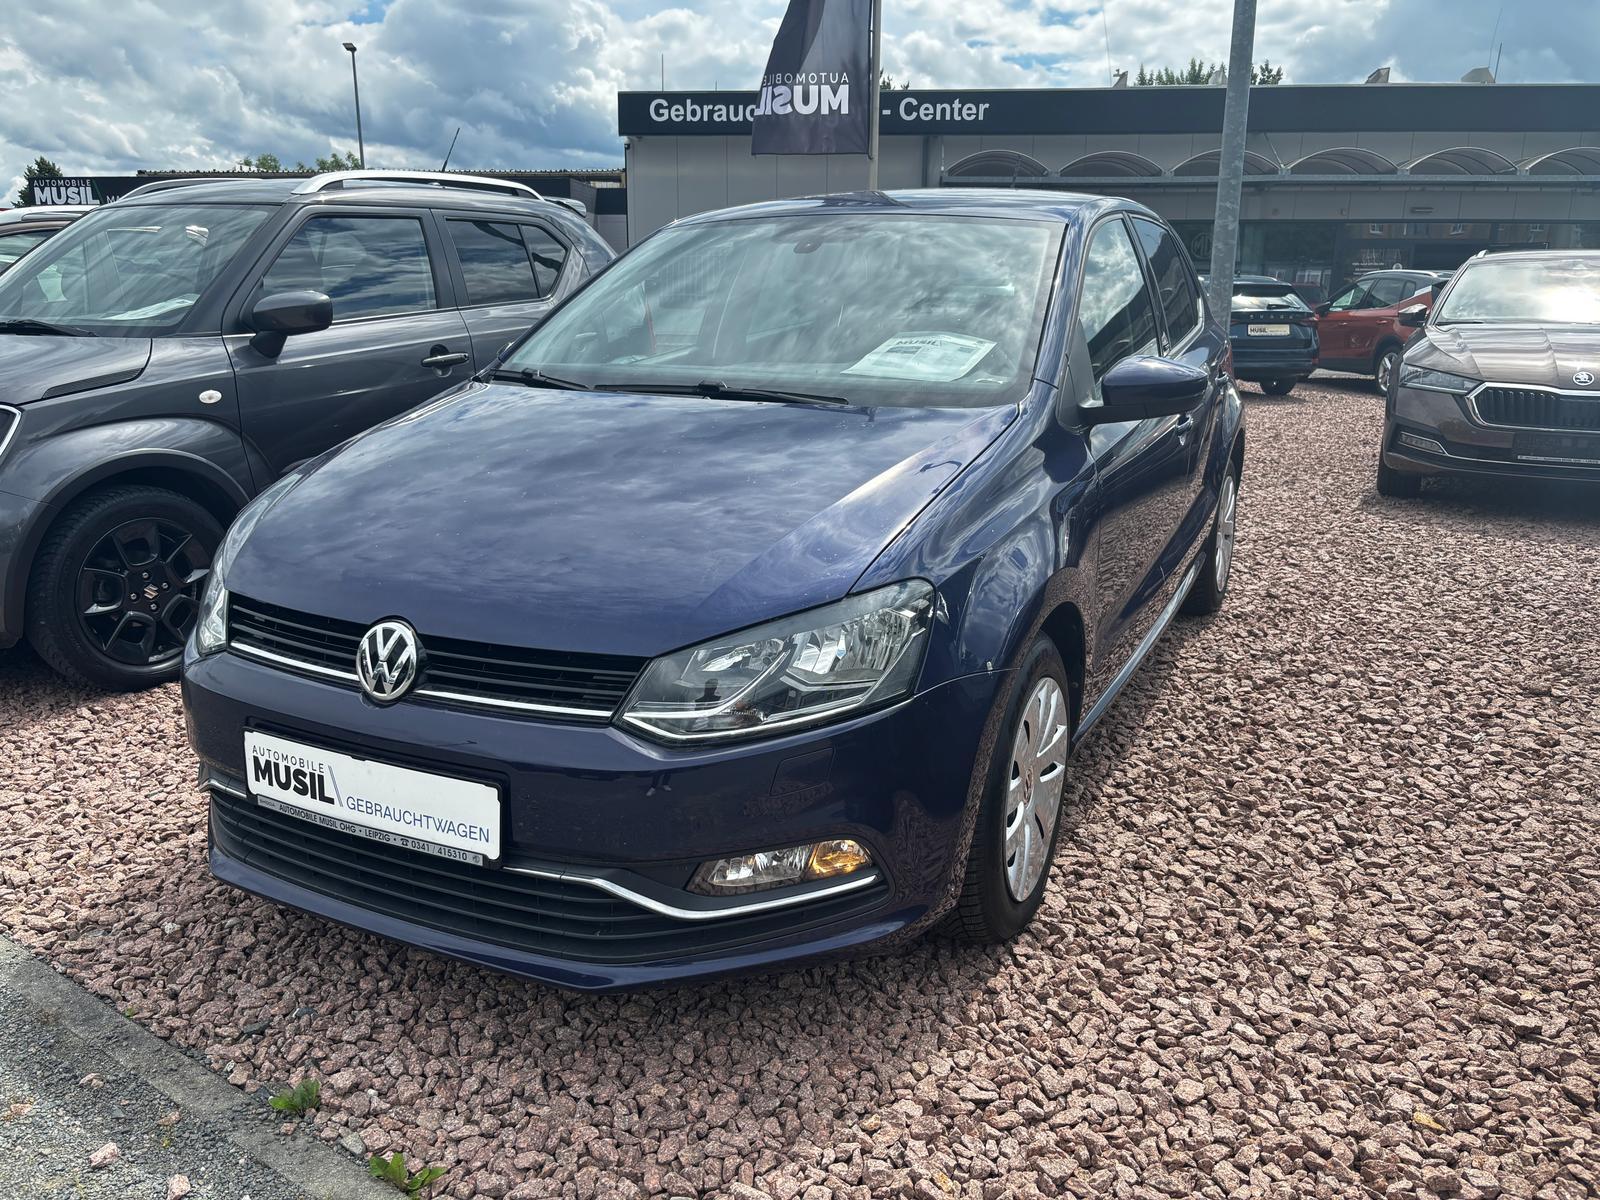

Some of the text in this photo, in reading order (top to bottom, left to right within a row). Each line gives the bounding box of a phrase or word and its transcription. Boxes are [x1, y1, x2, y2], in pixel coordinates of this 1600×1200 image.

[899, 97, 990, 121] Center
[33, 179, 91, 187] AUTOMOBILE
[34, 186, 100, 205] MUSIL
[252, 745, 324, 773] AUTOMOBILE
[253, 755, 335, 805] MUSIL
[280, 804, 318, 823] AUTOMOBILE
[319, 816, 338, 829] MUSIL
[339, 822, 357, 834] OHG
[364, 828, 391, 843] LEIPZIG
[411, 840, 430, 853] 0341
[437, 847, 468, 861] 415310
[346, 796, 490, 843] GEBRAUCHTWAGEN
